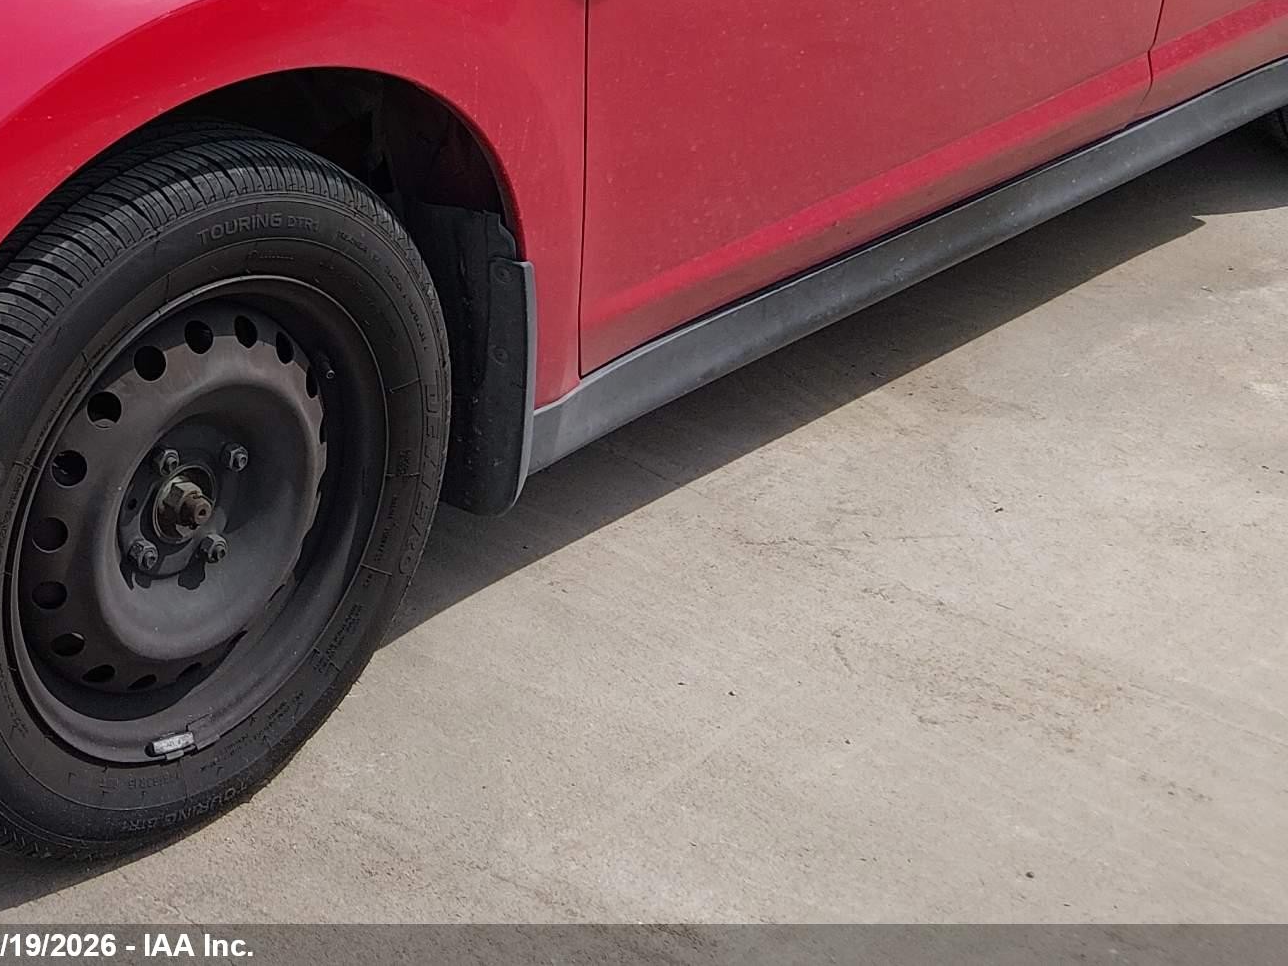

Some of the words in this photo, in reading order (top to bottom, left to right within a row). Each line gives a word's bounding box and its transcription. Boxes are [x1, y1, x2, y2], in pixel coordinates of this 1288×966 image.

[196, 212, 283, 246] TOURING
[287, 216, 321, 232] DTR1
[165, 780, 249, 823] TOURING
